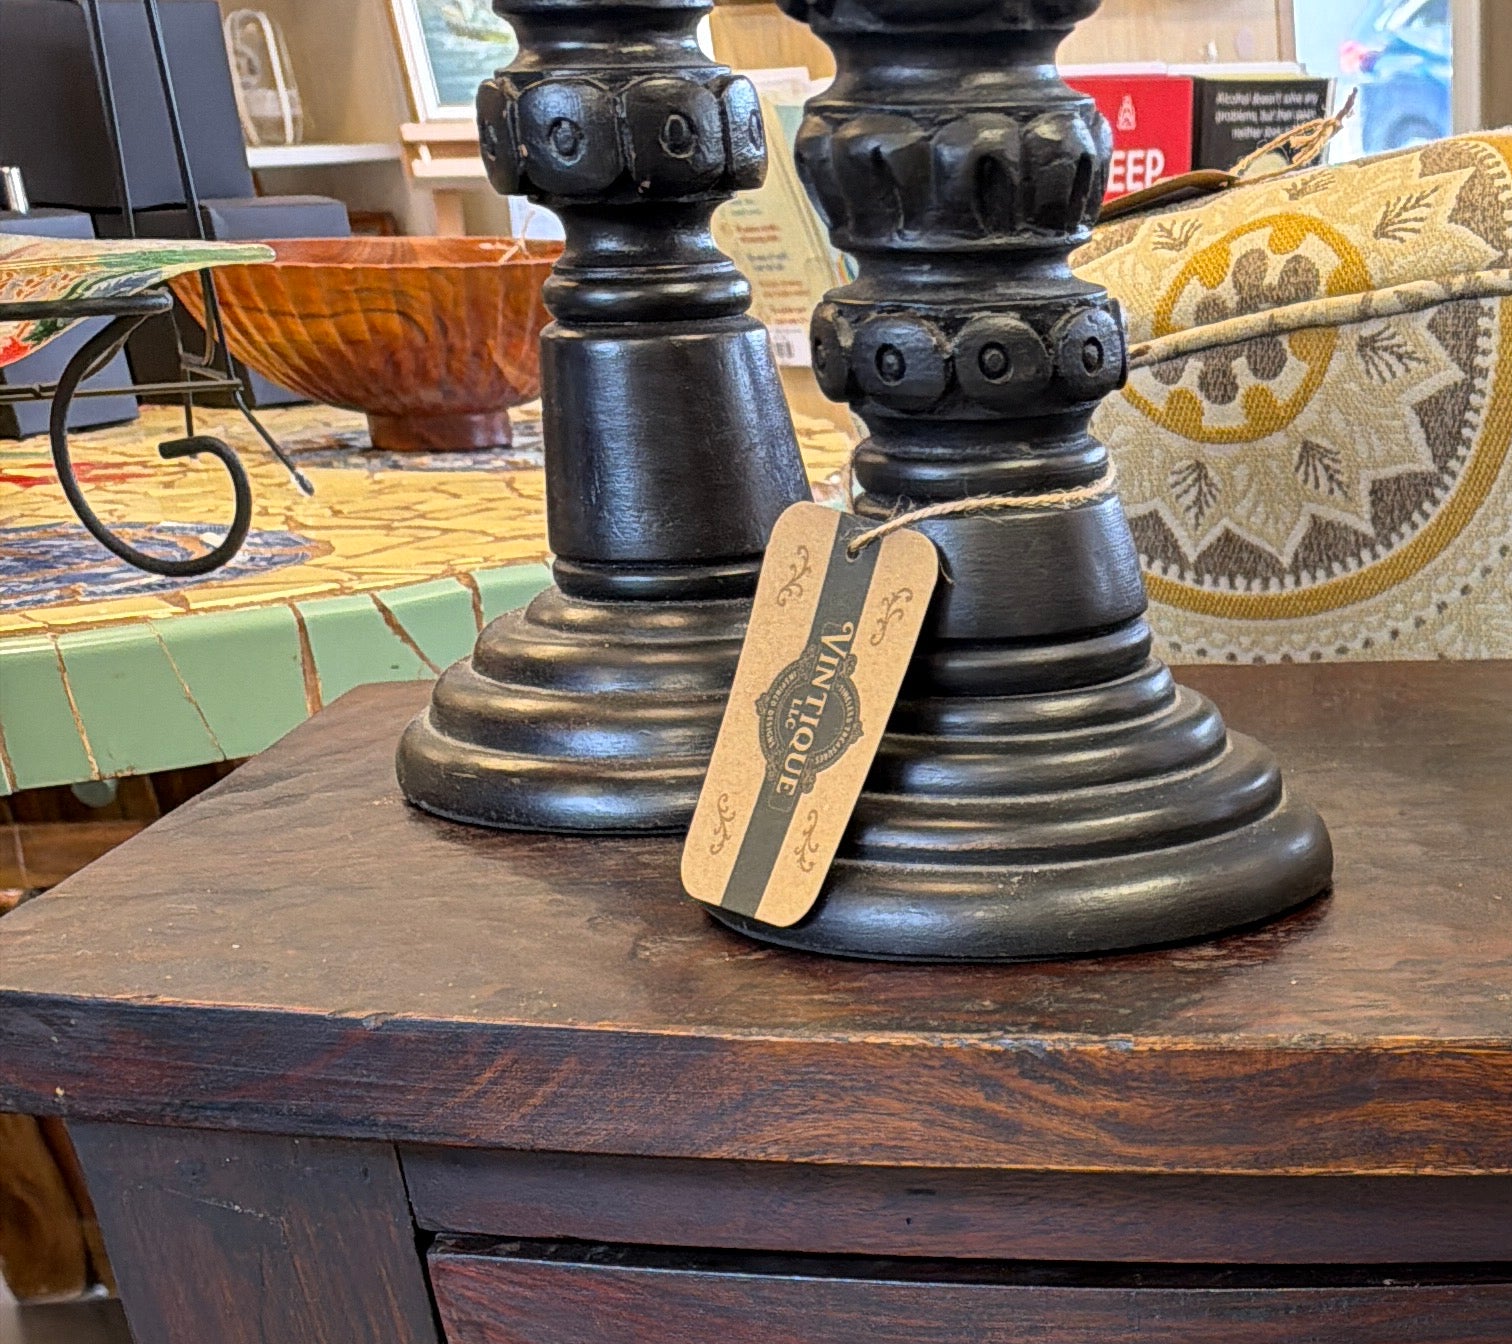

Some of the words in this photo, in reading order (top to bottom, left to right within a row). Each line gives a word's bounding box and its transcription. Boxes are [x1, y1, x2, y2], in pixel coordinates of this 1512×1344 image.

[1106, 148, 1165, 192] EEP
[776, 622, 854, 795] VINTIQUE
[784, 700, 802, 730] LLC
